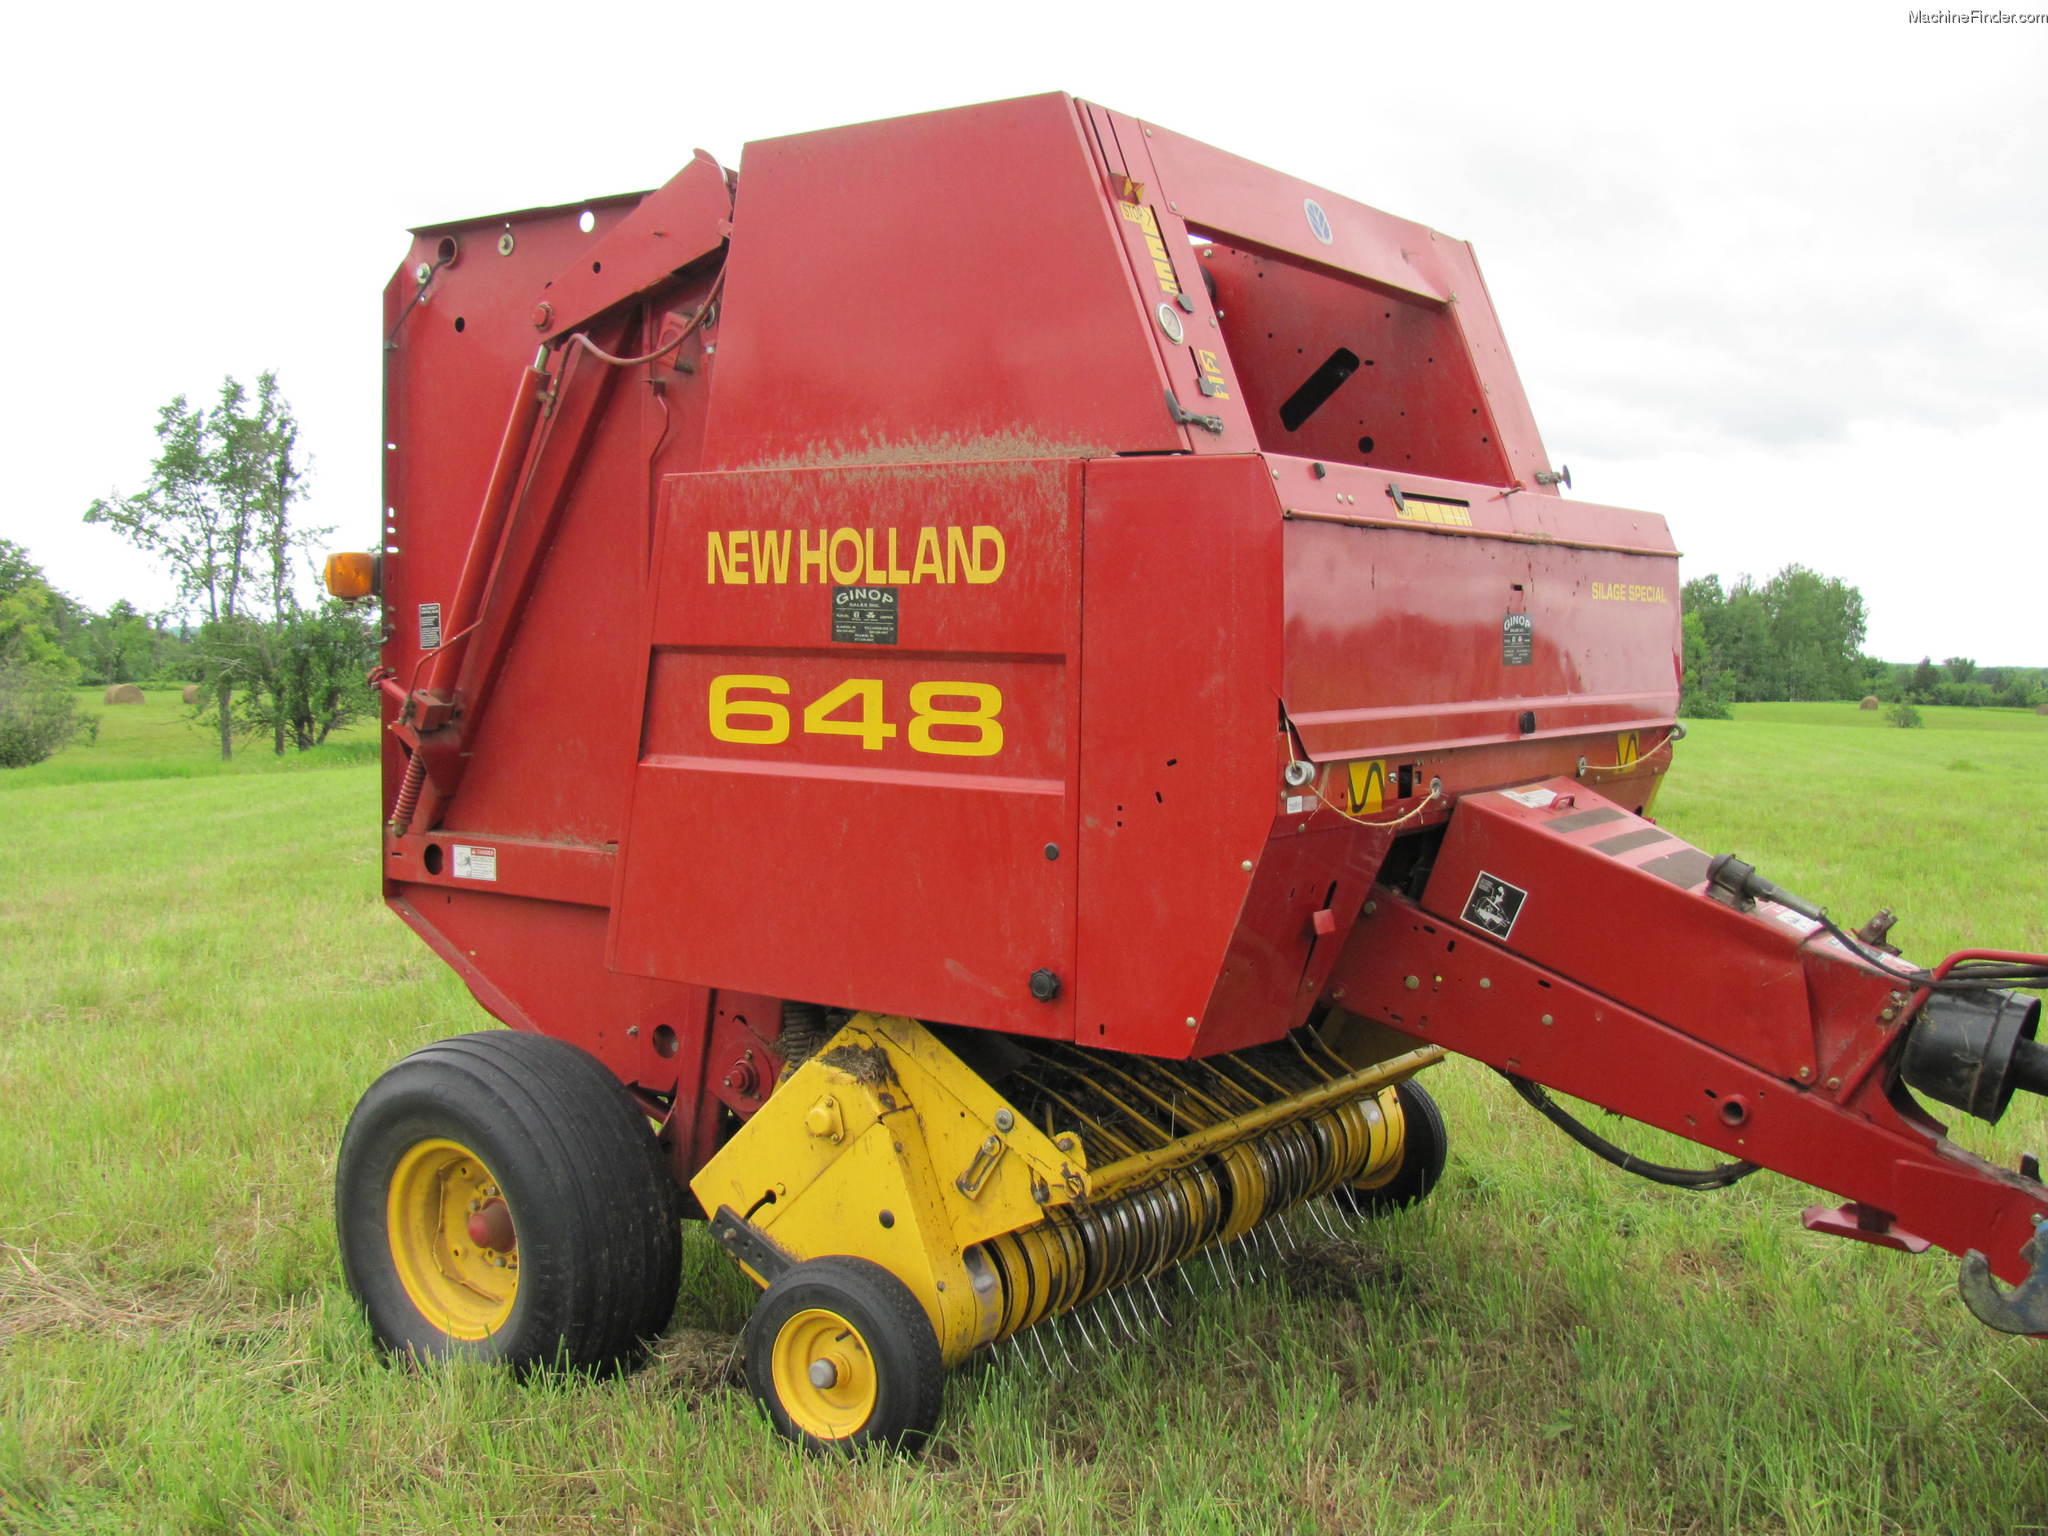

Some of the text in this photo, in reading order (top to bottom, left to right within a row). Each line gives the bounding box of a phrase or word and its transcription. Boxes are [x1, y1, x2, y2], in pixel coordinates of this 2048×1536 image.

[707, 525, 1006, 586] NEW HOLLAND
[836, 588, 894, 605] GINOP
[1591, 581, 1667, 603] SILAGE SPECIAL
[708, 674, 1004, 757] 648
